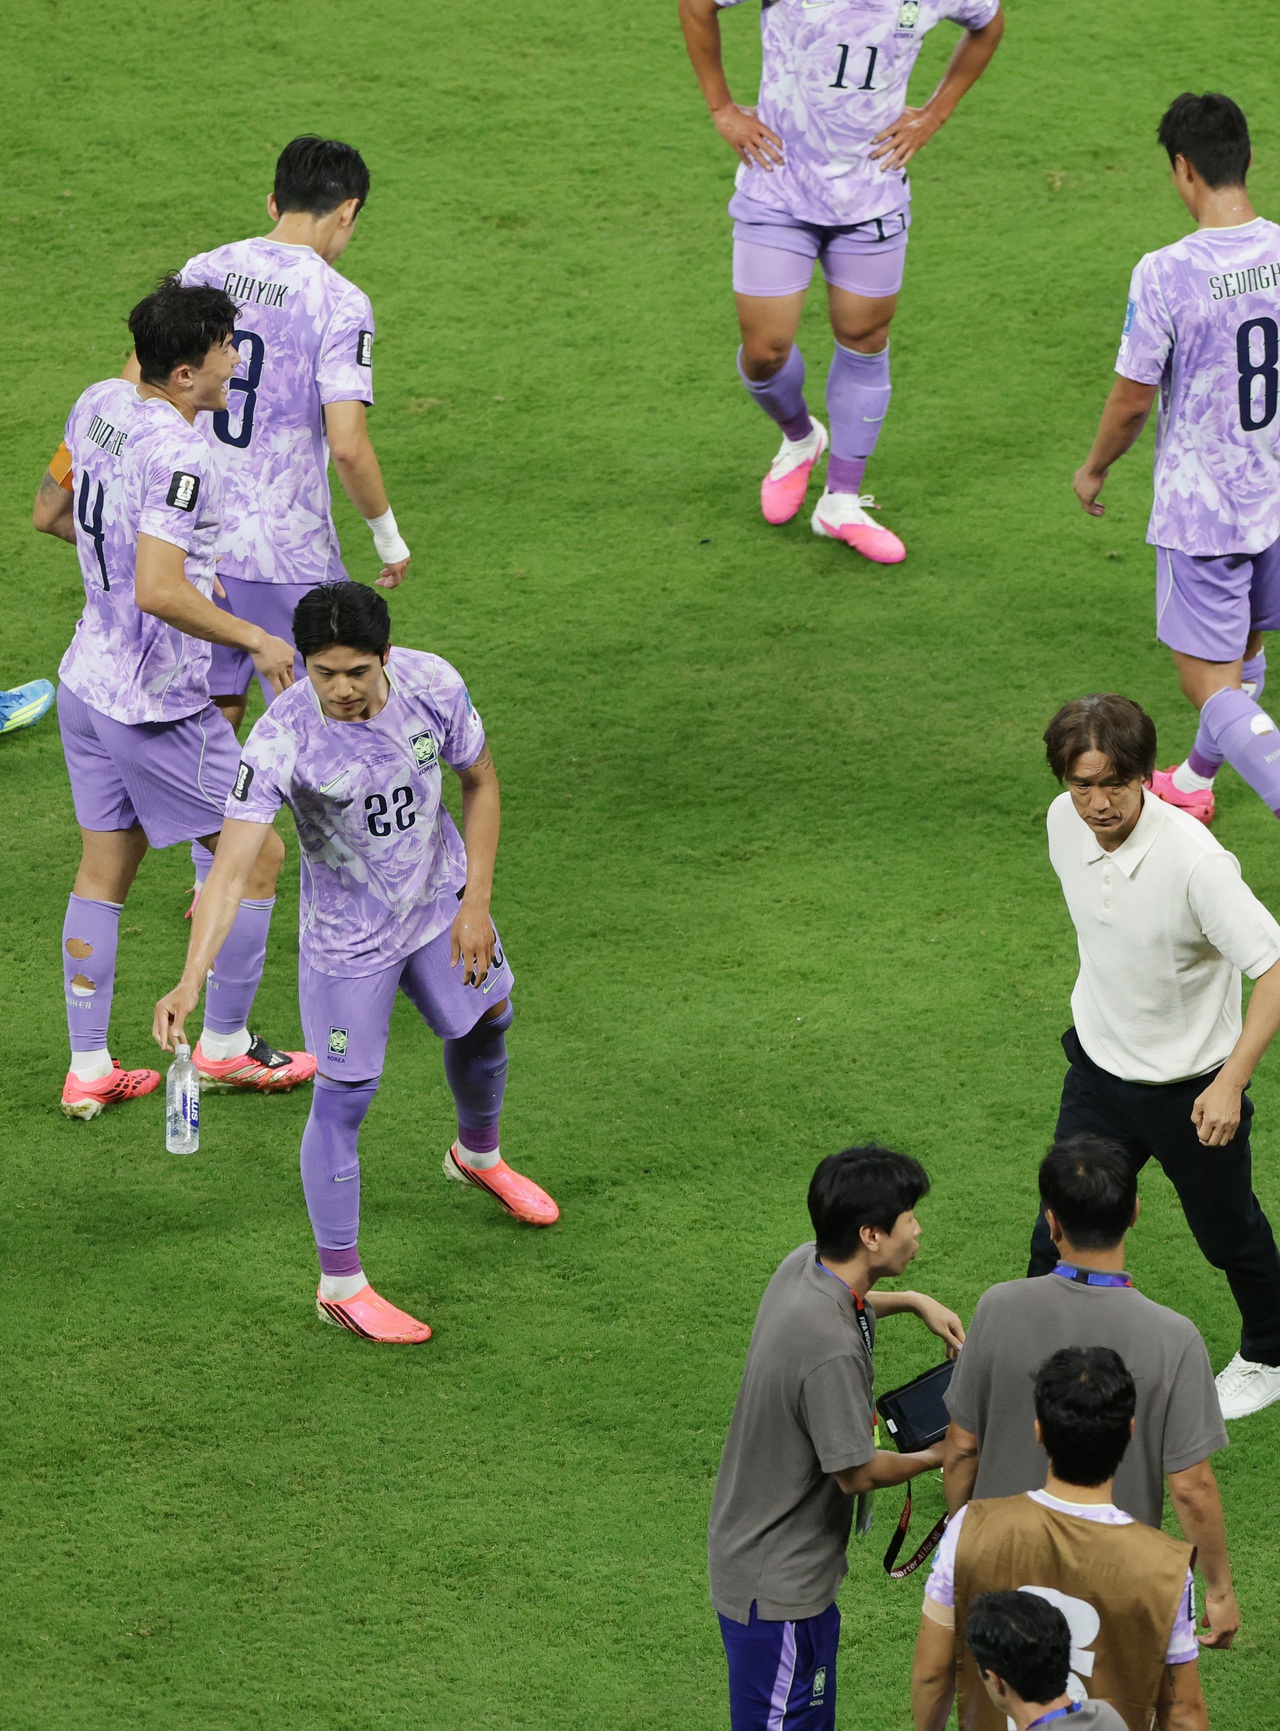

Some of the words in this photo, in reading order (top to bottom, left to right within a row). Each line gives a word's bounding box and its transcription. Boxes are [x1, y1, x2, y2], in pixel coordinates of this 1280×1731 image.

[829, 44, 878, 91] 11
[224, 272, 289, 308] GIHYUK
[1236, 316, 1280, 432] 8
[87, 414, 128, 457] MINAE
[78, 468, 111, 592] 4
[418, 761, 438, 777] KOREA
[364, 785, 416, 837] 22
[65, 996, 92, 1010] OREA
[326, 1055, 346, 1064] KOREA
[890, 1560, 918, 1579] marter
[923, 1541, 934, 1553] for
[933, 1531, 941, 1541] all
